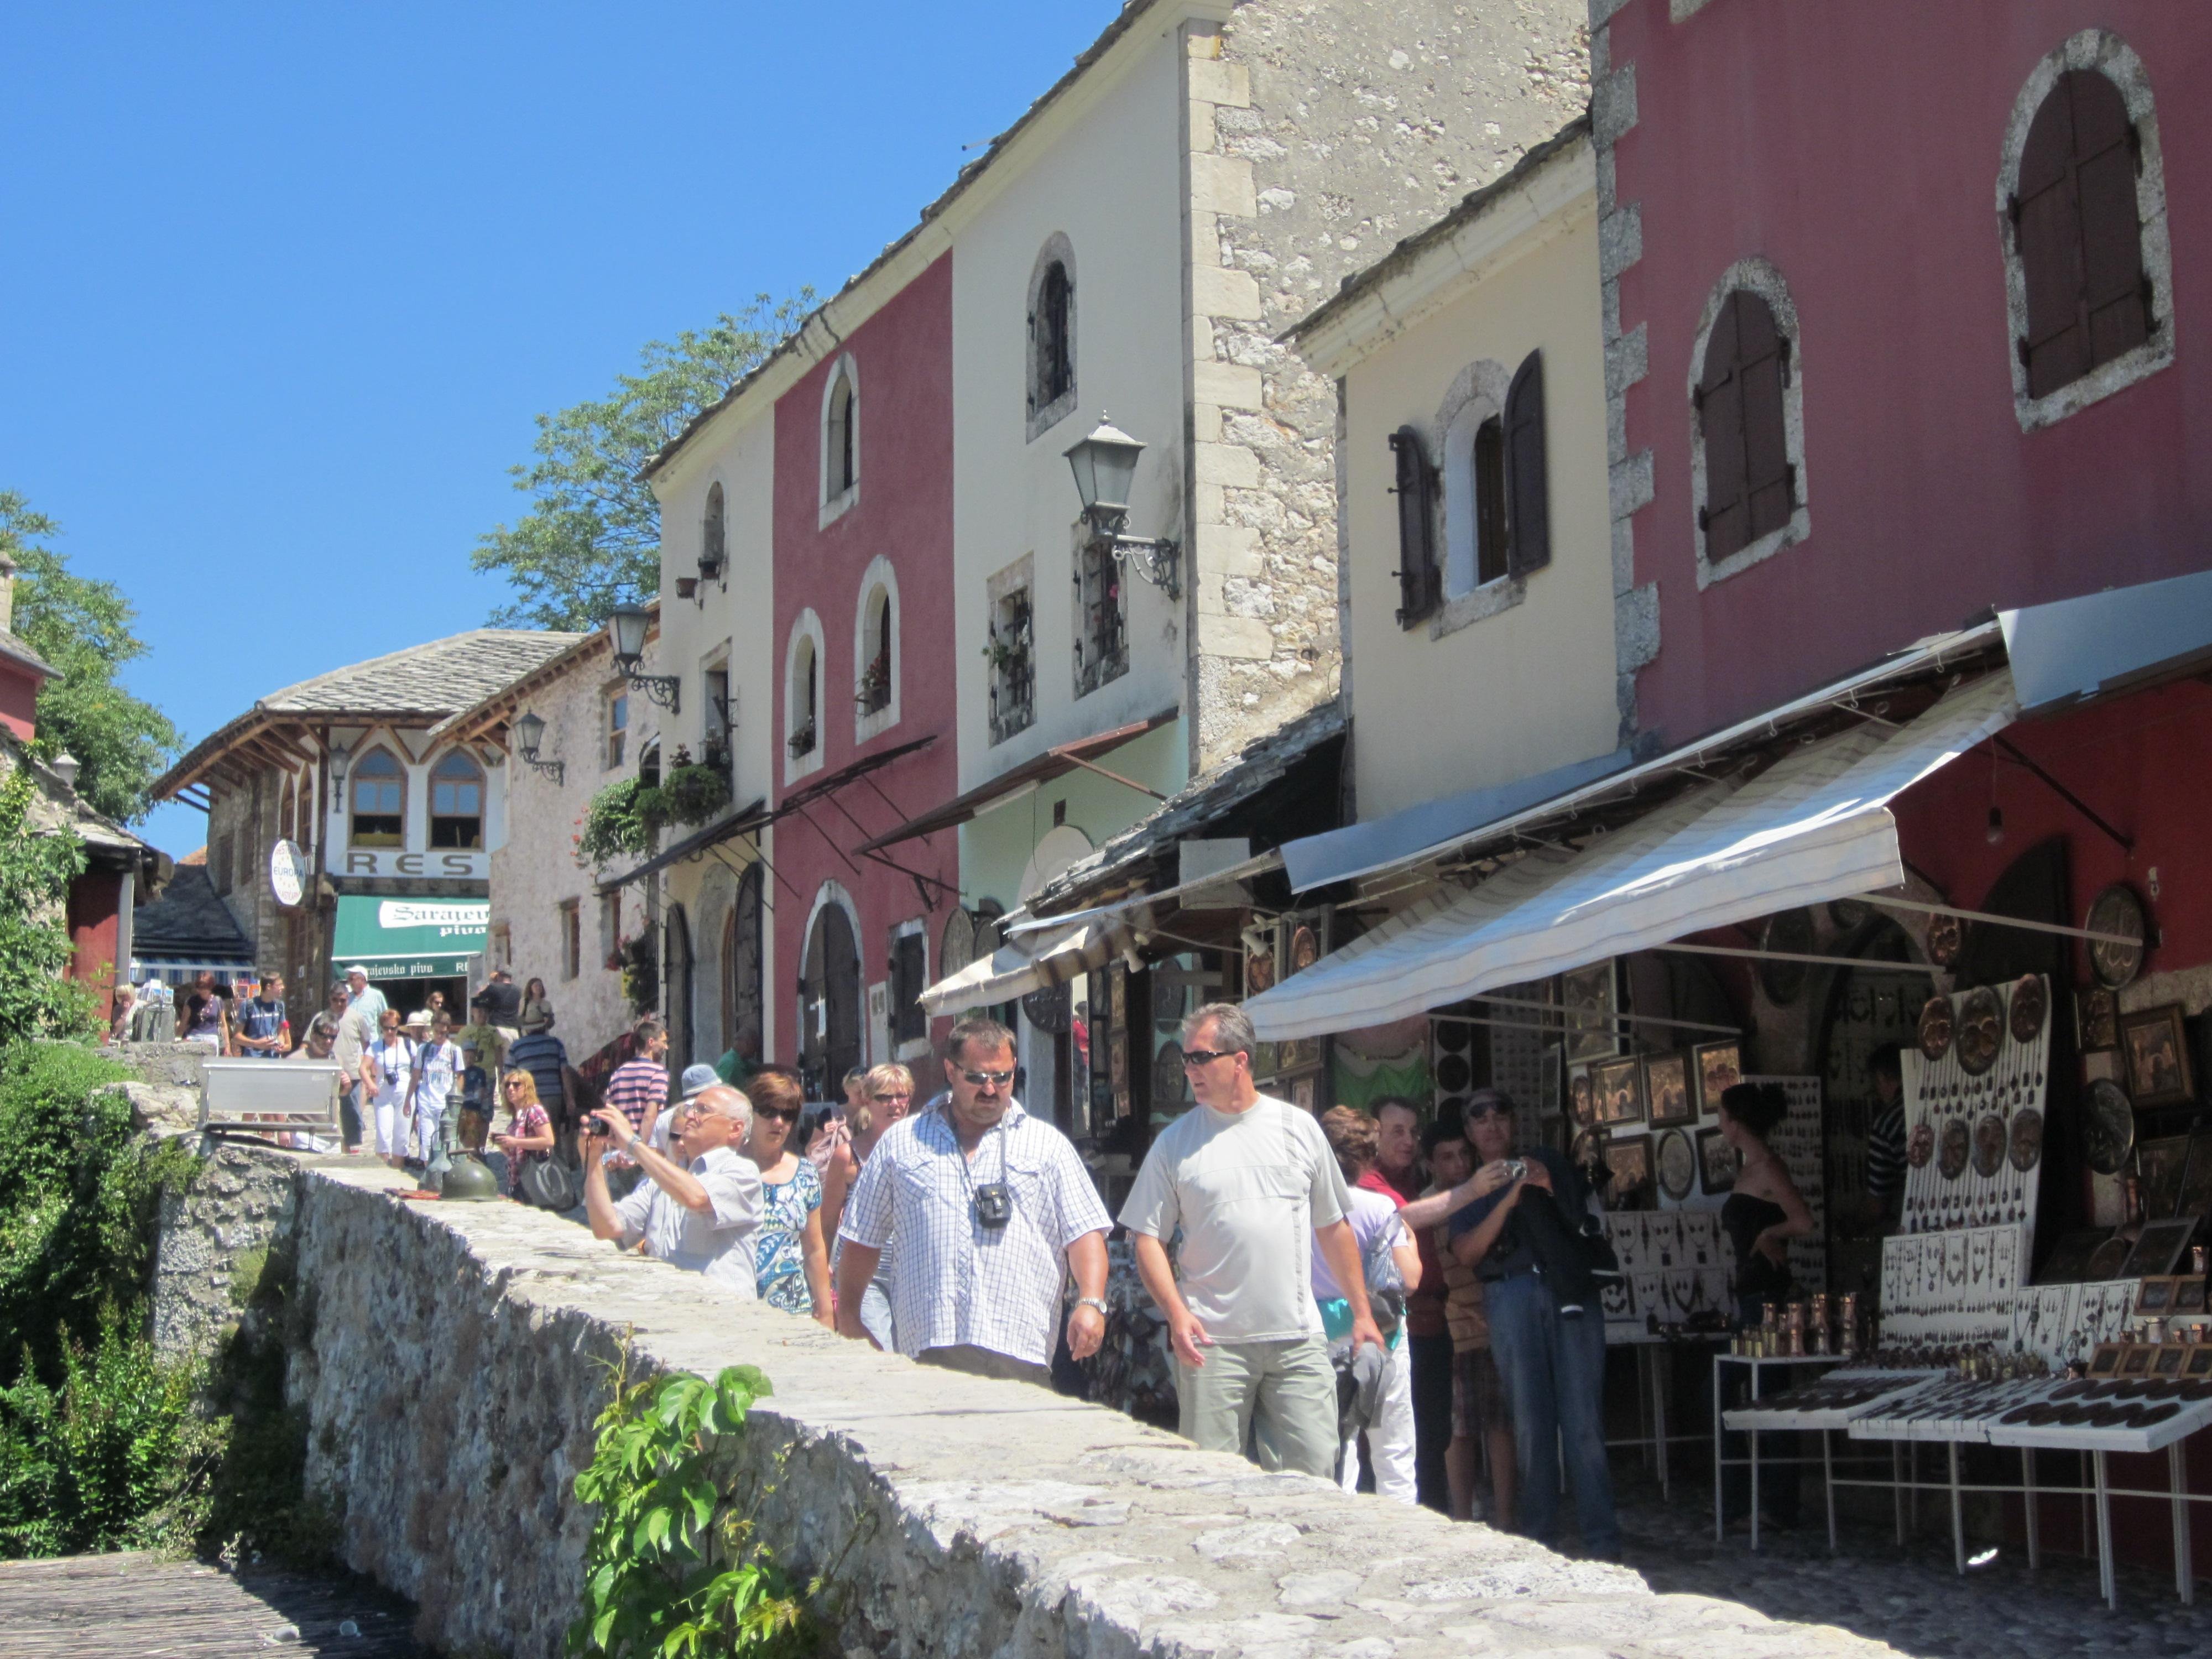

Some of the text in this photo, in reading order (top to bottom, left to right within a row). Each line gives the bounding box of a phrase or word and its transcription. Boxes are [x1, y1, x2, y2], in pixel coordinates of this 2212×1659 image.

[347, 853, 473, 875] RES
[273, 866, 304, 878] EUROPA
[394, 906, 489, 922] Sarajev
[440, 925, 486, 937] pivo
[410, 963, 433, 975] pivo
